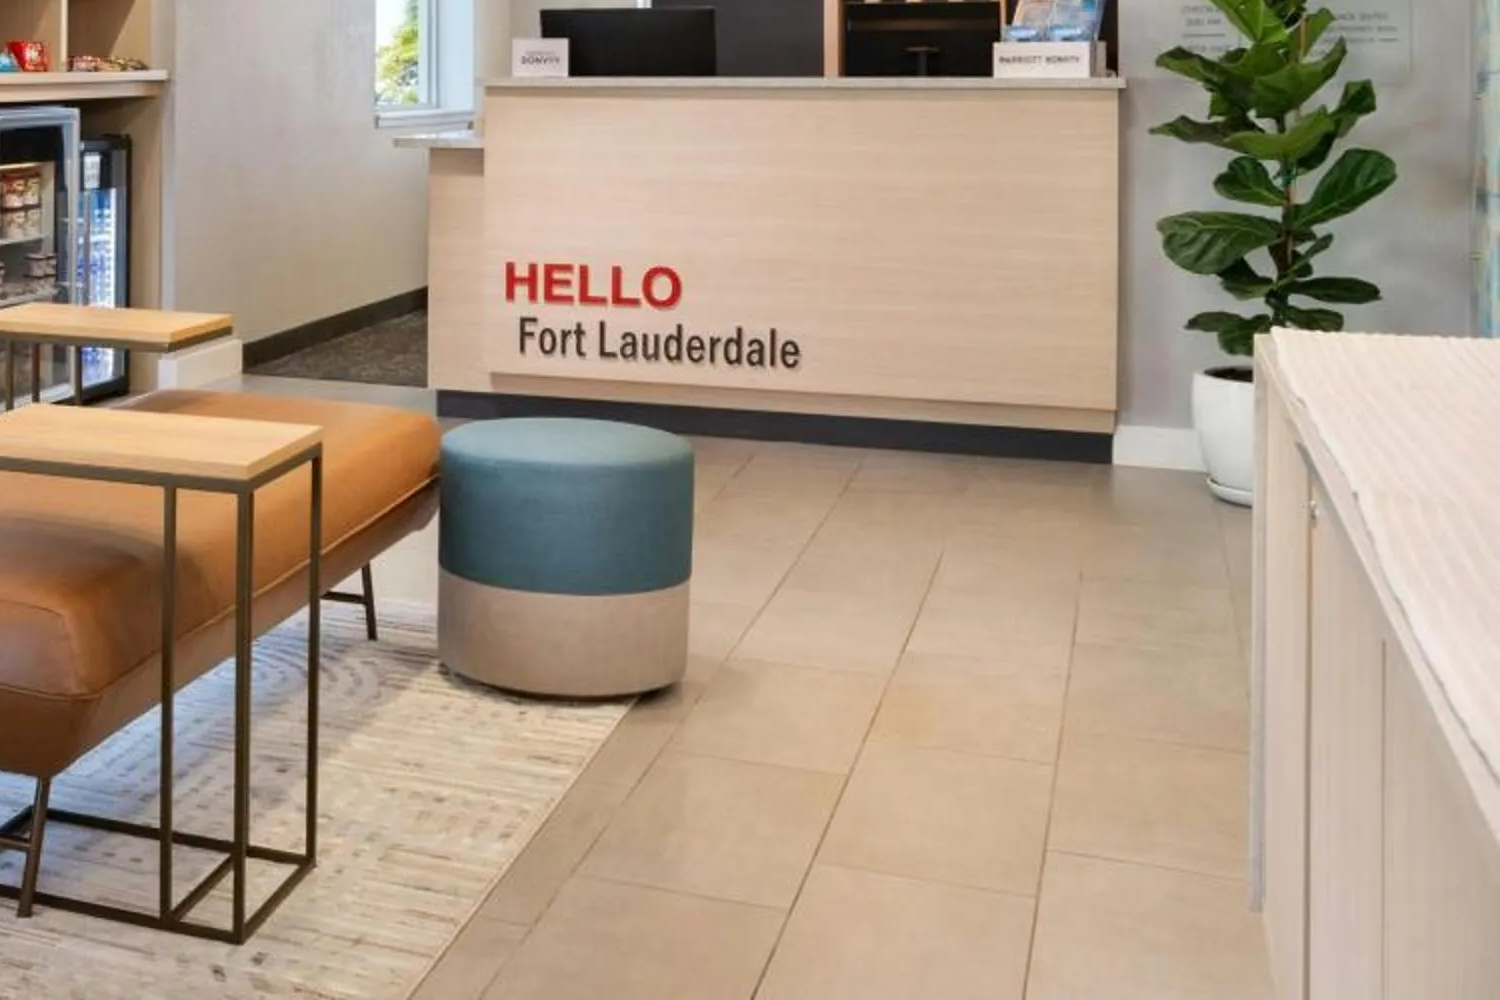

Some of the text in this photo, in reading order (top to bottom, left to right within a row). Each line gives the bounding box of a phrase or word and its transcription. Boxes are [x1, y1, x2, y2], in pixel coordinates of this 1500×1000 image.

[504, 261, 682, 310] HELLO
[518, 316, 801, 370] Fort Lauderdale
